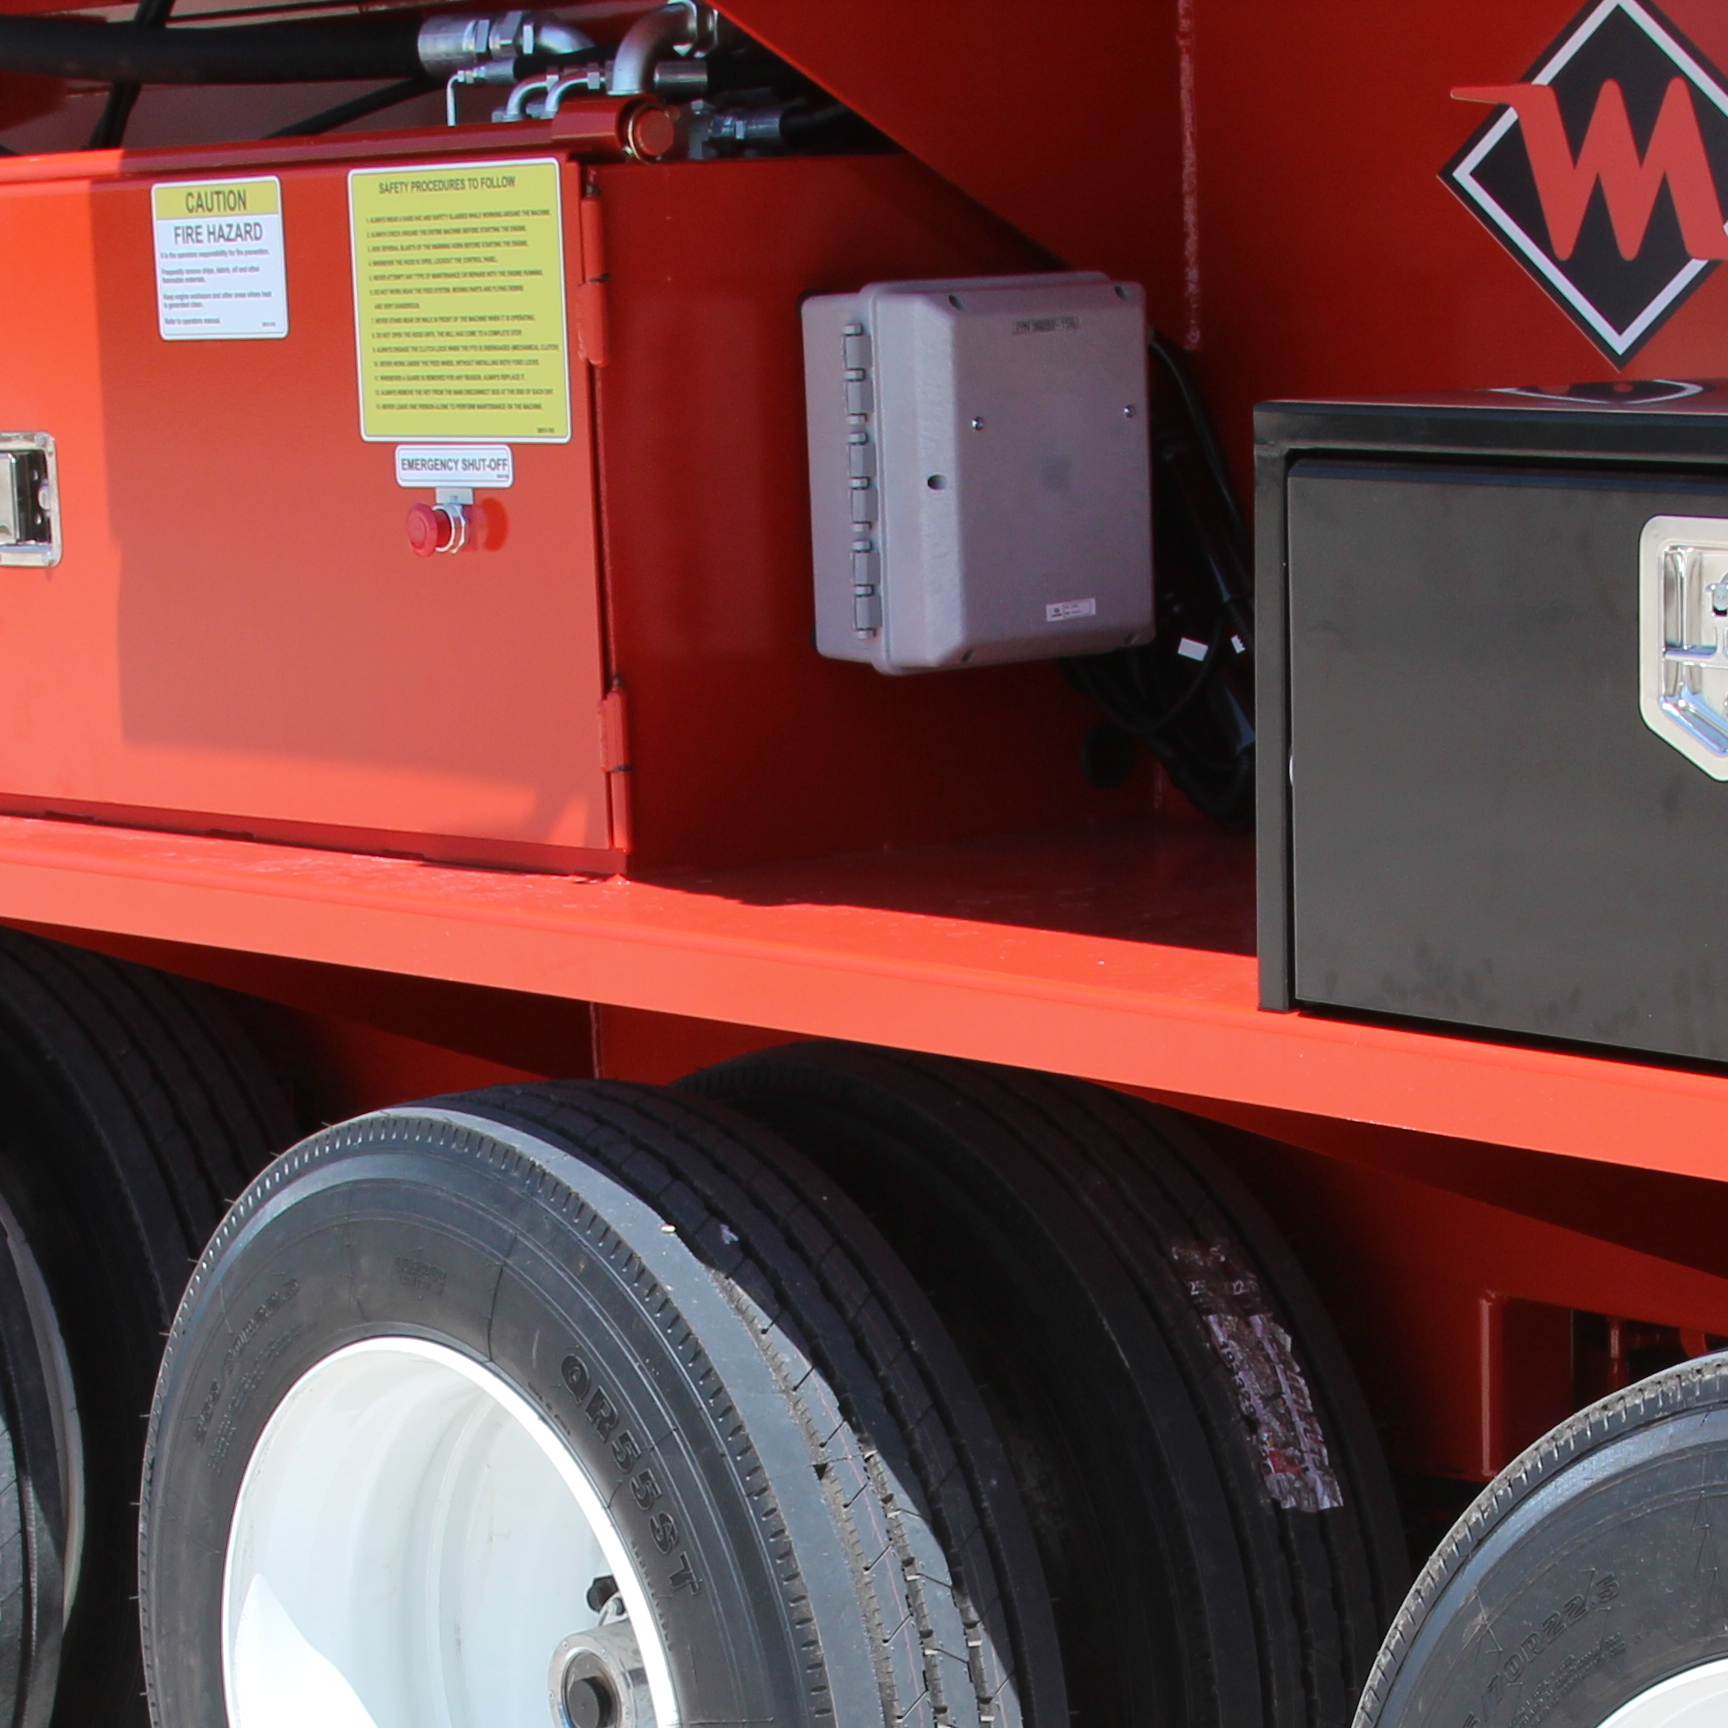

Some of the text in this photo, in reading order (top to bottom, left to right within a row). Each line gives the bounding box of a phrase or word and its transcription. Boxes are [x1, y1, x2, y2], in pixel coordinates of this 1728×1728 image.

[379, 175, 516, 194] SAFETY PROCEDURES TO FOLLOW
[186, 189, 247, 213] CAUTION
[174, 222, 264, 245] FIRE HAZARD
[401, 458, 508, 472] EMERGENCY SHUT-OFF
[560, 1352, 700, 1598] QR55ST
